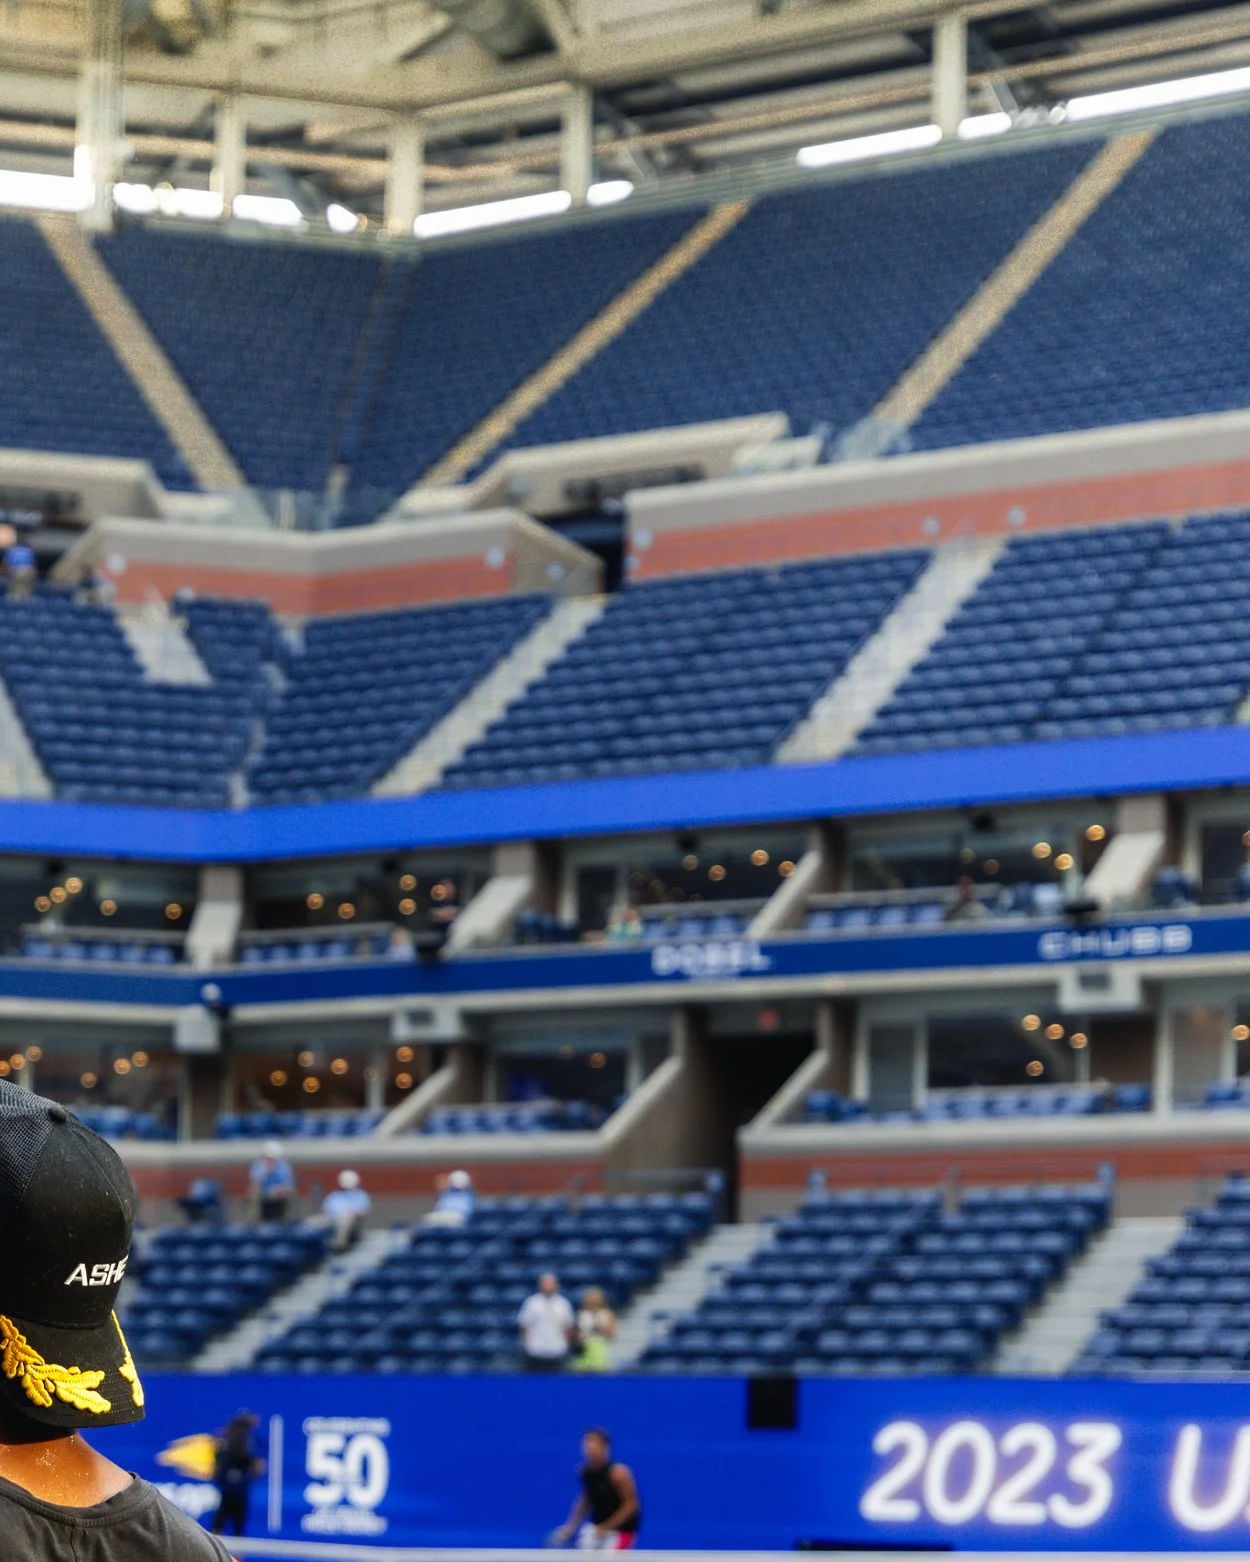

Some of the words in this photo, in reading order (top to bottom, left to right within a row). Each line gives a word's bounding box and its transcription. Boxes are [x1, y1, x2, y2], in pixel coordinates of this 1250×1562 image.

[1037, 924, 1193, 961] CHUBB
[303, 1432, 390, 1508] 50
[859, 1419, 1123, 1529] 2023
[1168, 1422, 1250, 1532] U
